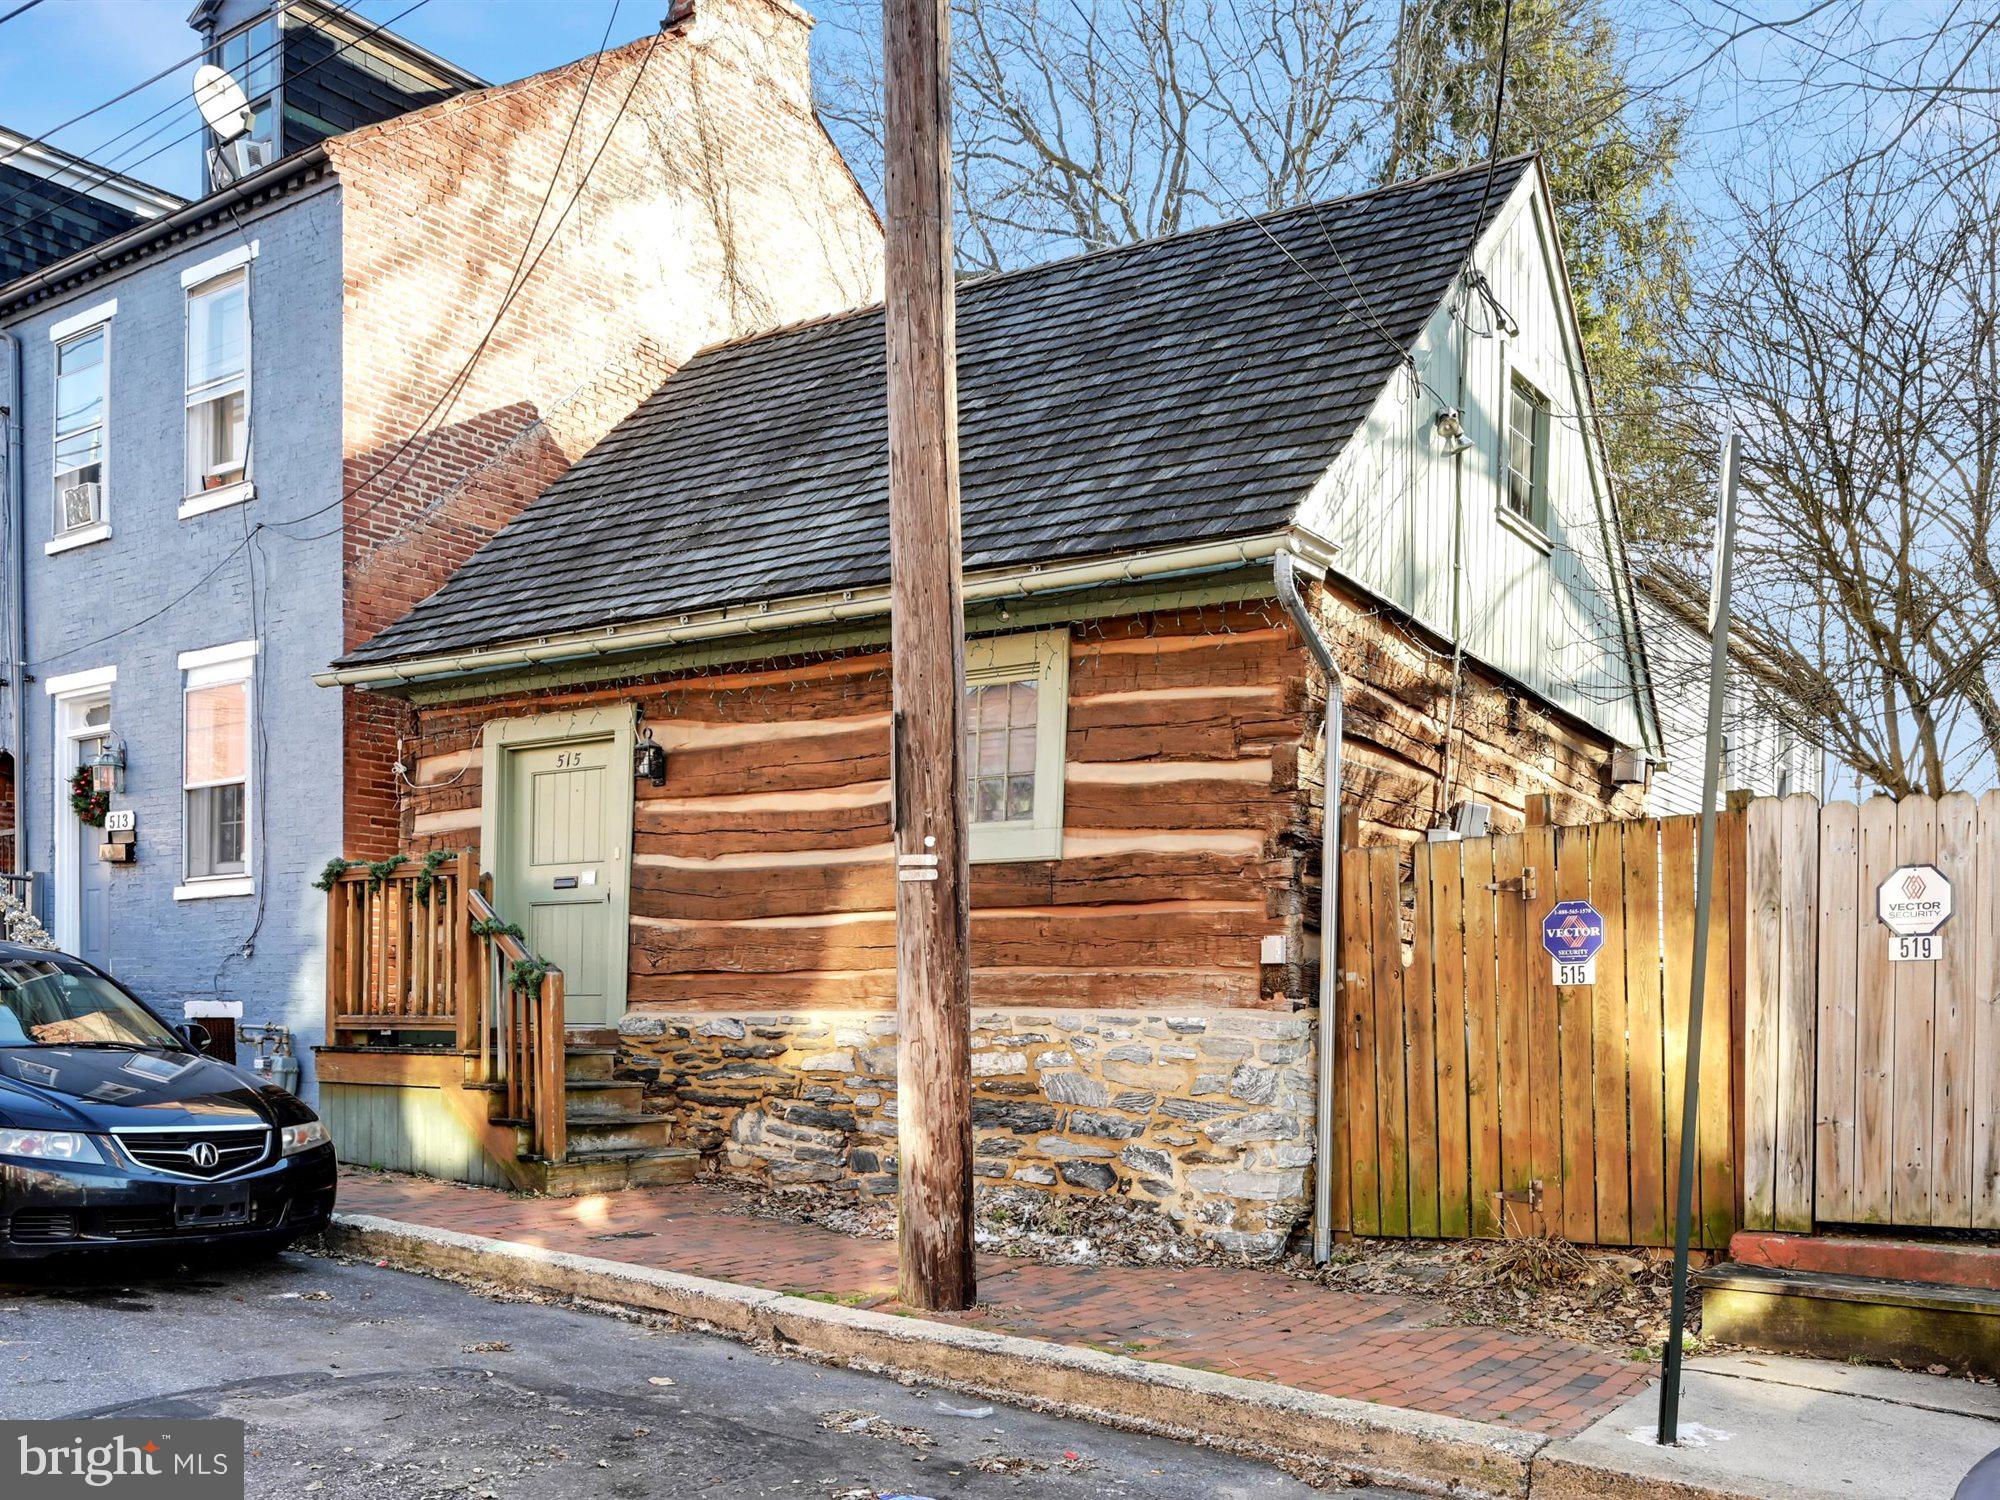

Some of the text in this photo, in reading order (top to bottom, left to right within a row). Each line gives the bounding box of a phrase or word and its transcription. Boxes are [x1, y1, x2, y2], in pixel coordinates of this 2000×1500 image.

[556, 751, 582, 768] 515
[109, 813, 129, 829] 513
[1888, 901, 1941, 911] VECTOR
[1888, 910, 1941, 919] SECURITY
[1546, 926, 1601, 938] VECTOR
[1900, 937, 1931, 959] 519
[1560, 965, 1586, 984] 515
